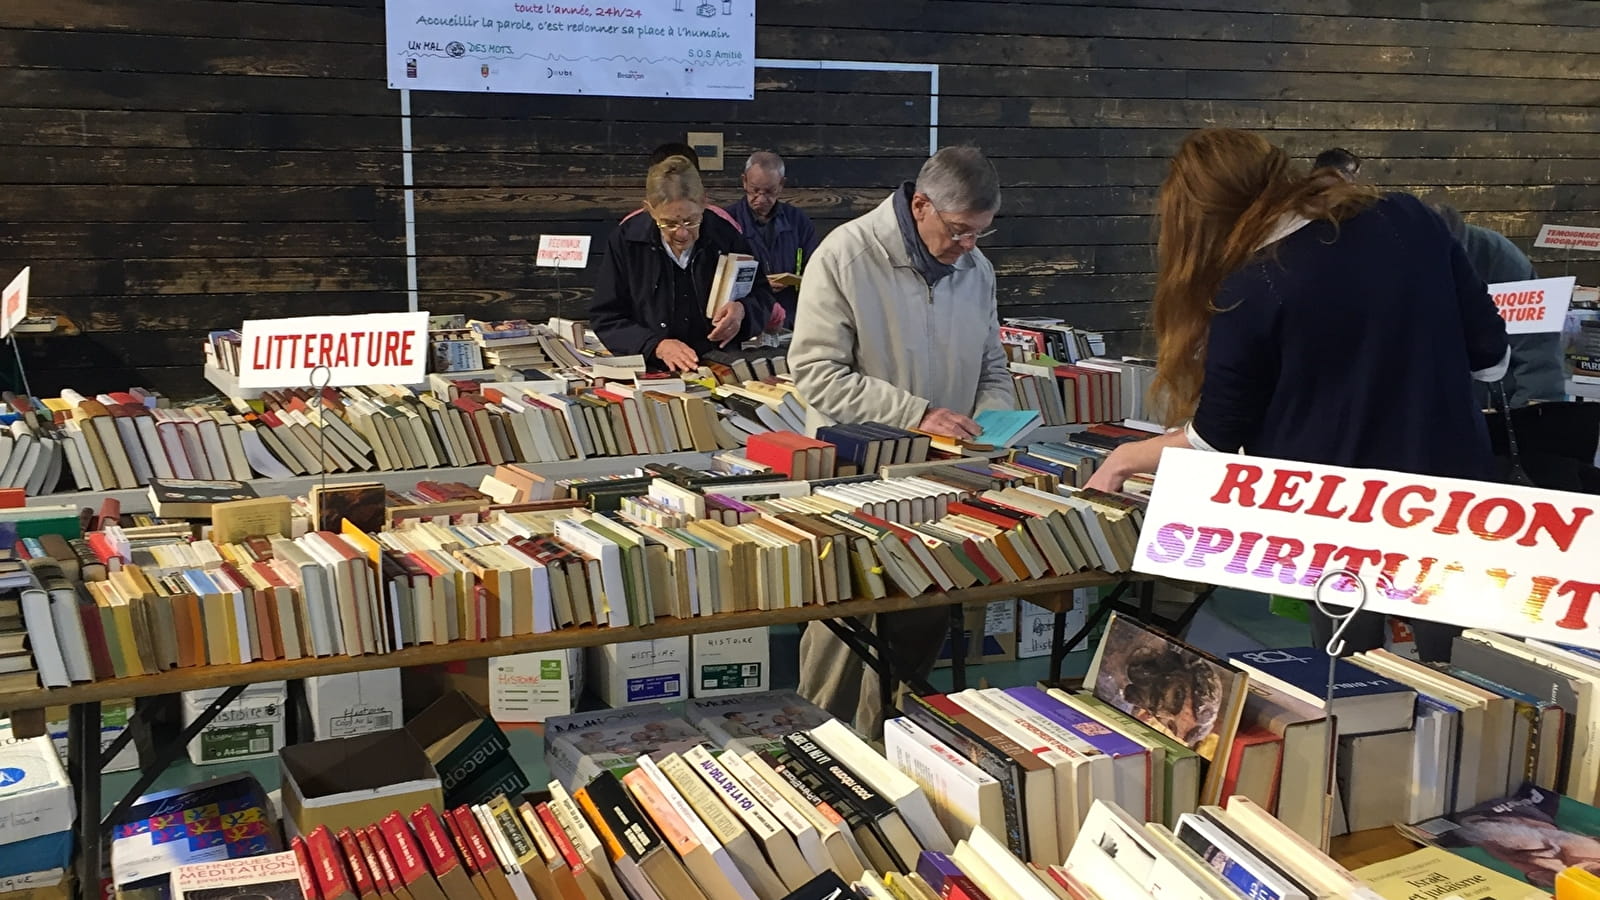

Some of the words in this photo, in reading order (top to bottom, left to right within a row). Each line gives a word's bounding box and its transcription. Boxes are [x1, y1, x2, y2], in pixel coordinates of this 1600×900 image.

[514, 3, 543, 13] toute
[546, 3, 592, 16] l'année,
[595, 7, 643, 18] 24h/24
[416, 14, 479, 27] Accueillir
[482, 17, 493, 28] la
[497, 19, 533, 32] parole,
[538, 20, 564, 32] c'est
[567, 22, 618, 34] redonner
[622, 26, 634, 35] sa
[638, 25, 665, 38] place
[668, 26, 674, 37] à
[678, 27, 730, 39] l'humain
[252, 330, 416, 371] LITTERATURE
[1210, 463, 1594, 552] RELIGION
[699, 759, 727, 789] AU-DELA
[722, 782, 737, 793] DE
[730, 790, 743, 801] LA
[737, 797, 755, 811] FOI
[179, 856, 272, 873] TECHNIQUES
[275, 853, 293, 861] DE
[180, 860, 295, 880] MEDITATION
[1405, 871, 1450, 888] Israël
[1418, 874, 1487, 900] judaïsme
